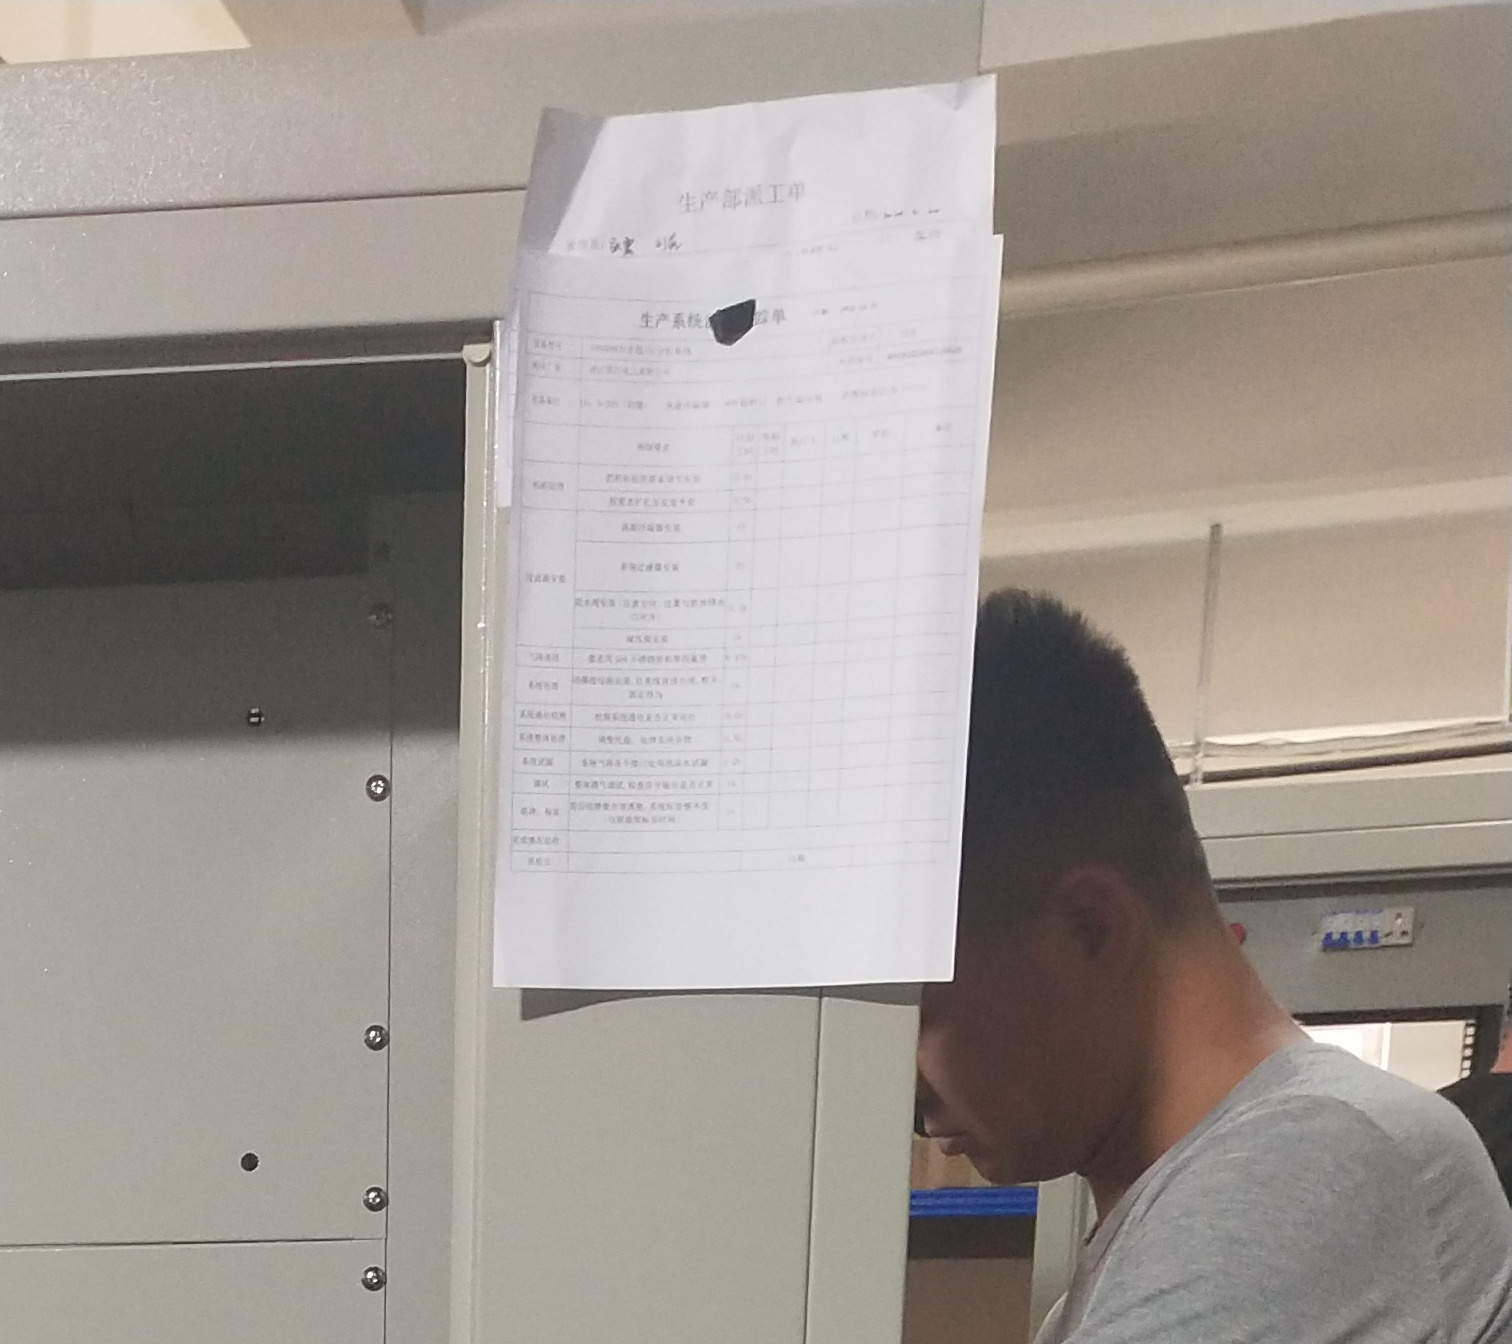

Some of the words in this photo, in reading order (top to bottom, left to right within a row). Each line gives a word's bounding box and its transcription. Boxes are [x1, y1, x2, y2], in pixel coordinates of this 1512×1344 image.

[678, 181, 807, 214] 生产部派工单
